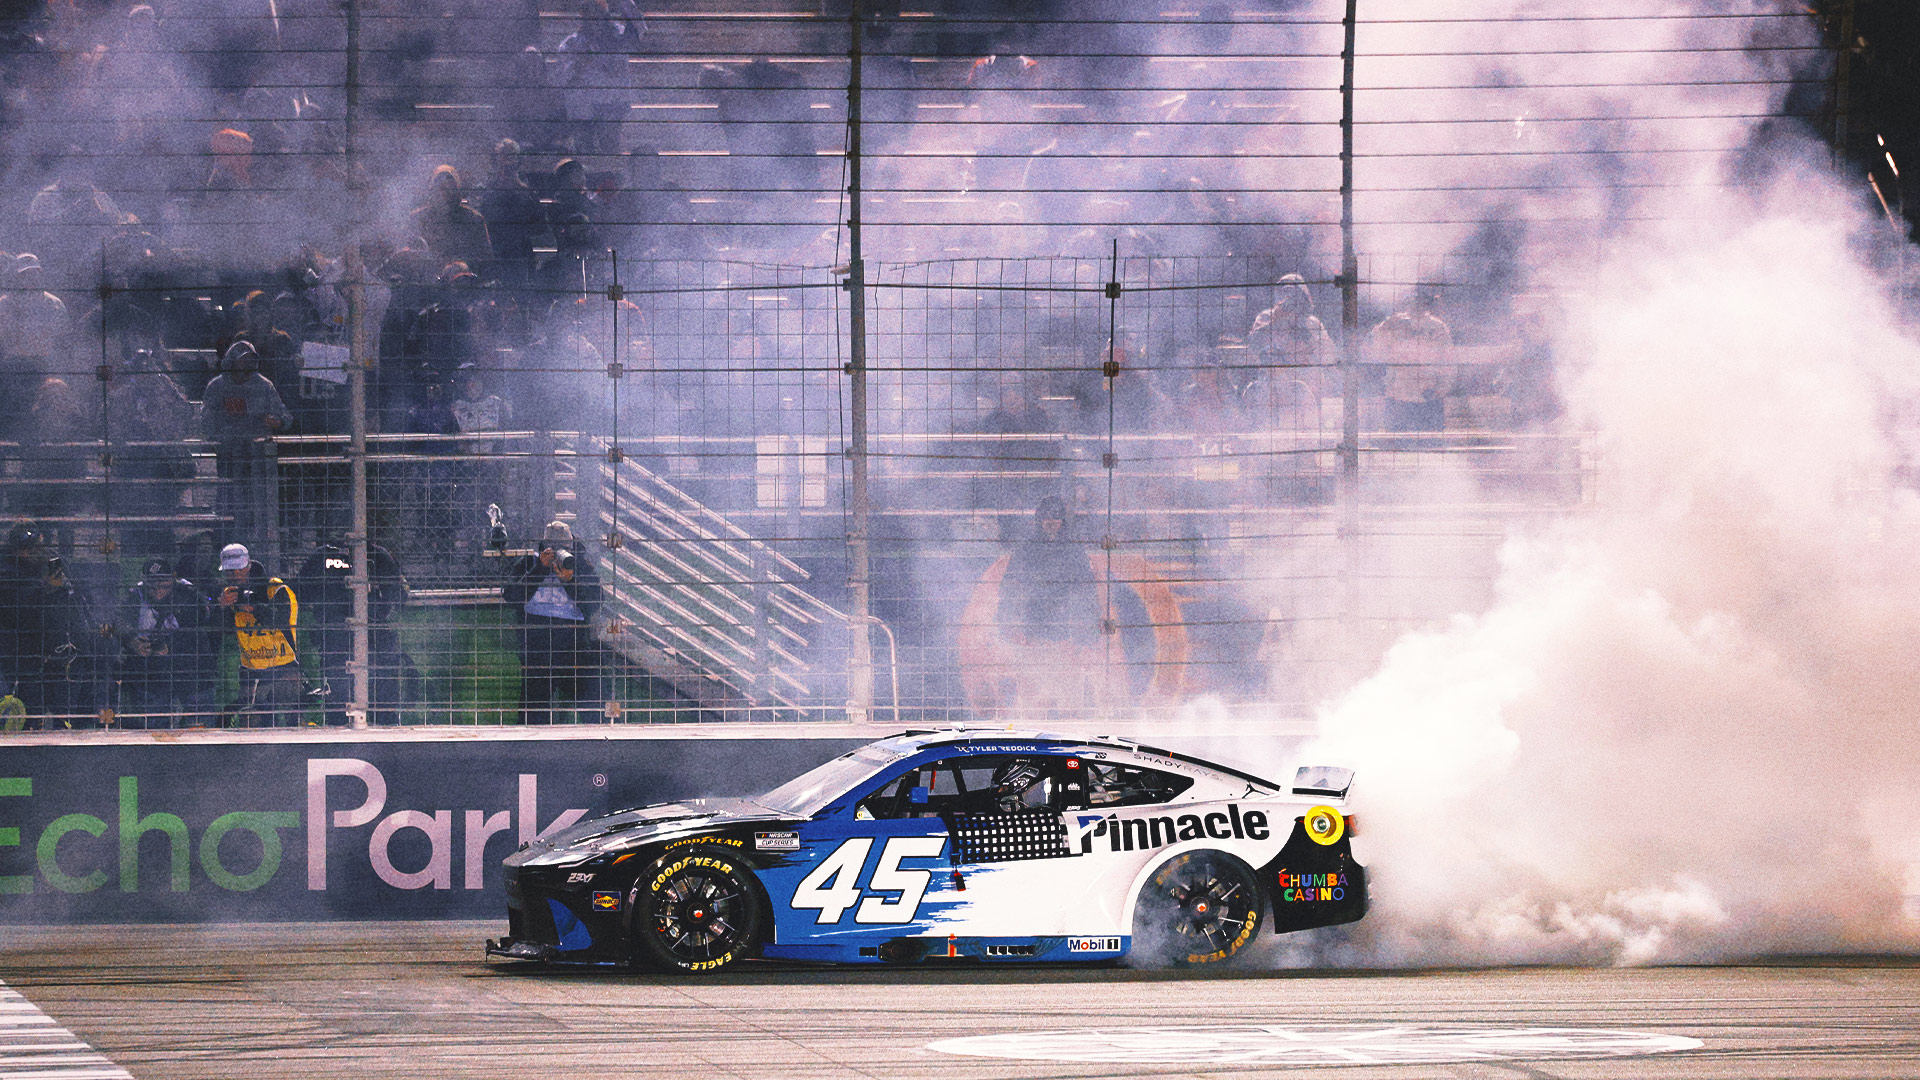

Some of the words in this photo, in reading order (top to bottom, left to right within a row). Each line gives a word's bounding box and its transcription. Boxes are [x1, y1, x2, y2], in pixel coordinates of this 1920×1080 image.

[1078, 803, 1270, 853] Pinnacle
[790, 836, 948, 925] 45
[1278, 872, 1349, 888] CHUMBA
[1284, 887, 1345, 902] CASINO
[1070, 939, 1104, 950] Mobil
[690, 951, 732, 970] EAGLE
